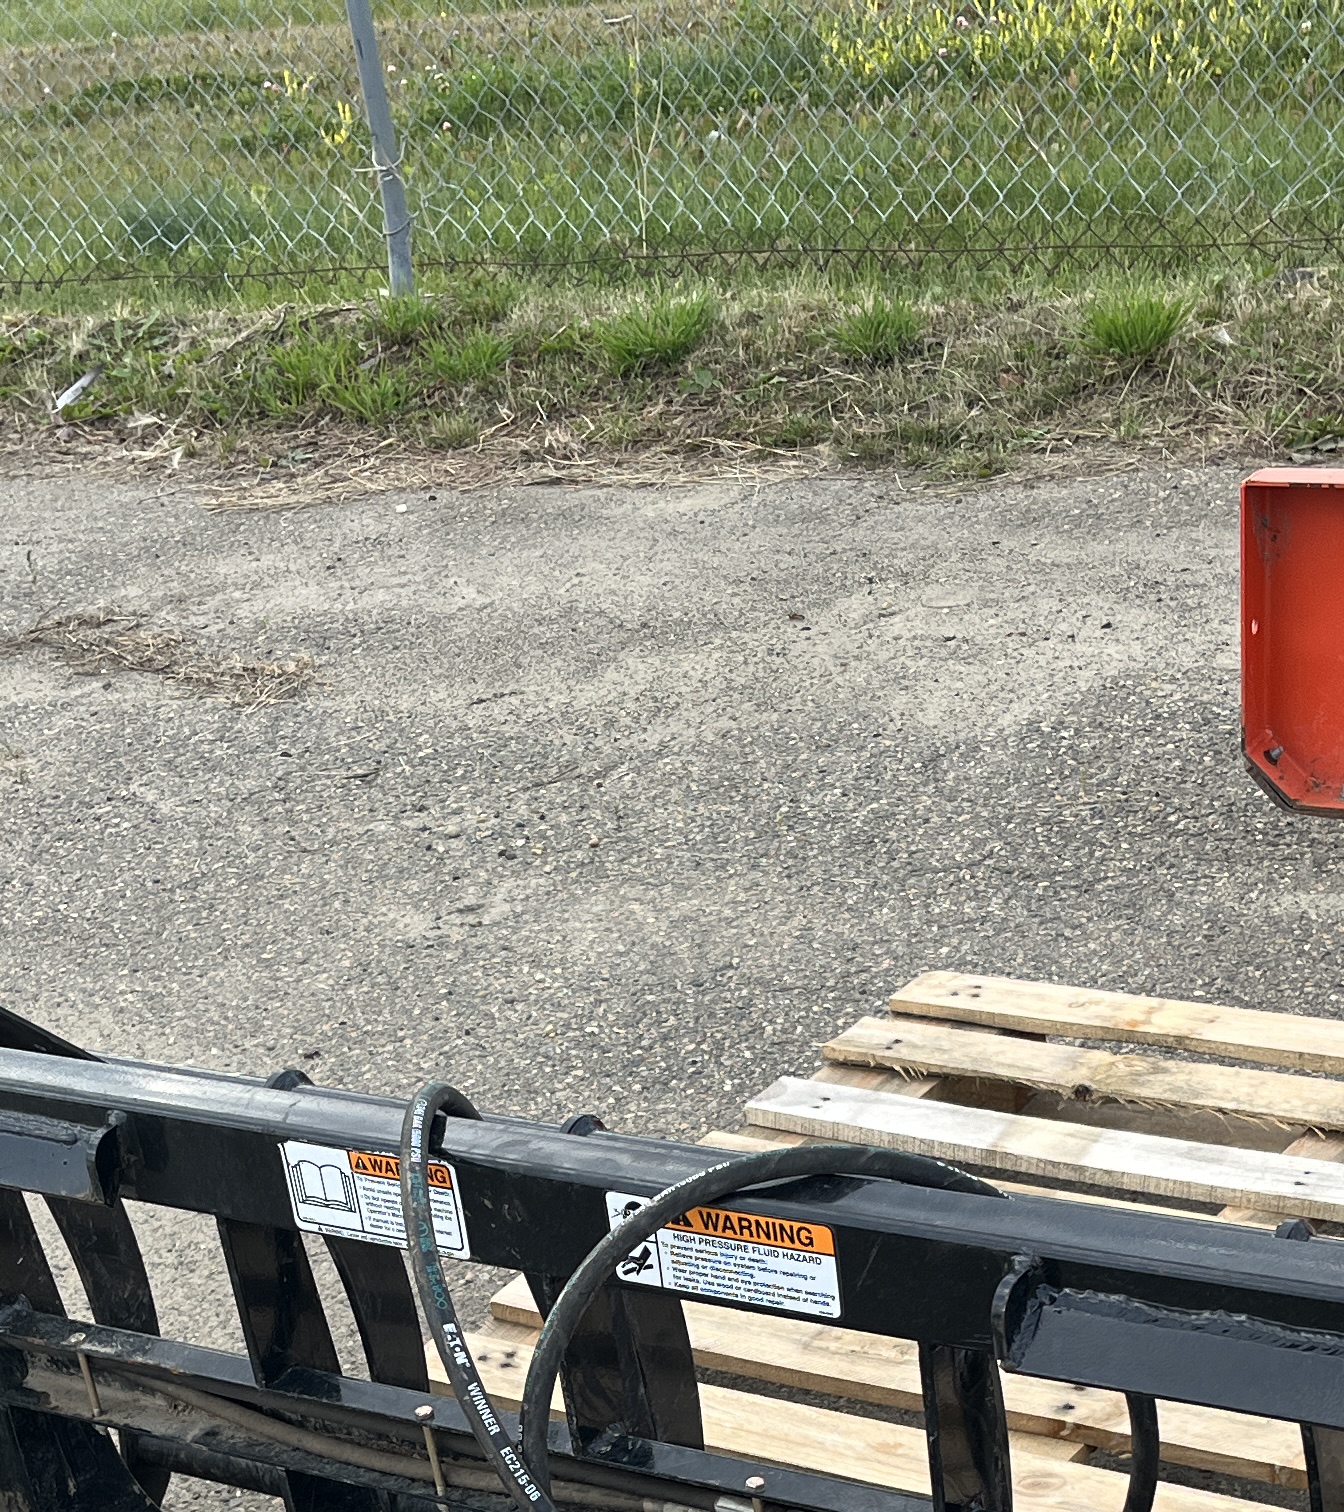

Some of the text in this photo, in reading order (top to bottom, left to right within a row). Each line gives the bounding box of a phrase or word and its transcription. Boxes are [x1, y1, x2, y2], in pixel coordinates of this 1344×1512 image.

[697, 1208, 816, 1248] WARNING
[672, 1232, 822, 1266] HIGH PRESSURE FLUID HAZARD
[467, 1381, 500, 1436] WINNER
